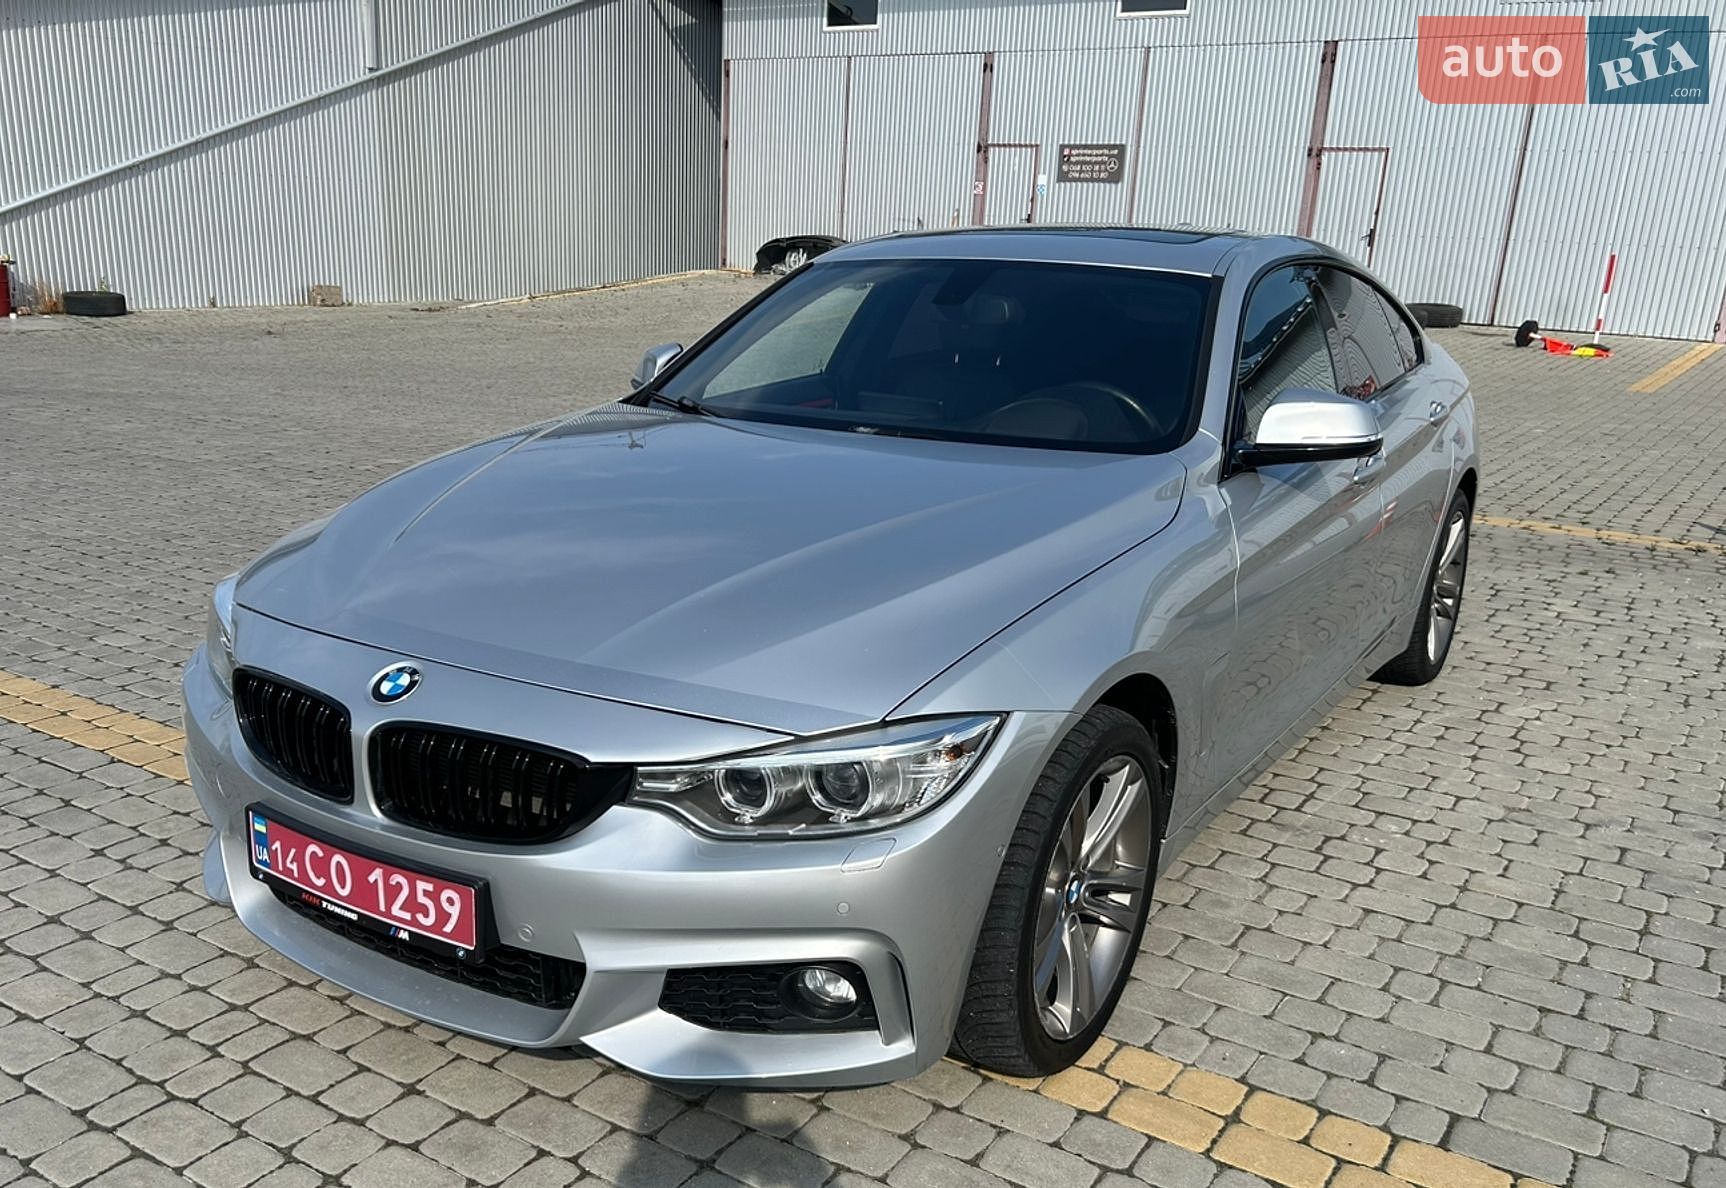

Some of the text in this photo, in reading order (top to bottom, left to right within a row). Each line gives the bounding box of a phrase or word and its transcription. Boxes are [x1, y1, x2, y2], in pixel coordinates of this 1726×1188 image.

[255, 844, 270, 863] UA
[271, 840, 462, 934] 14 CO 1259
[321, 900, 359, 921] TUNING
